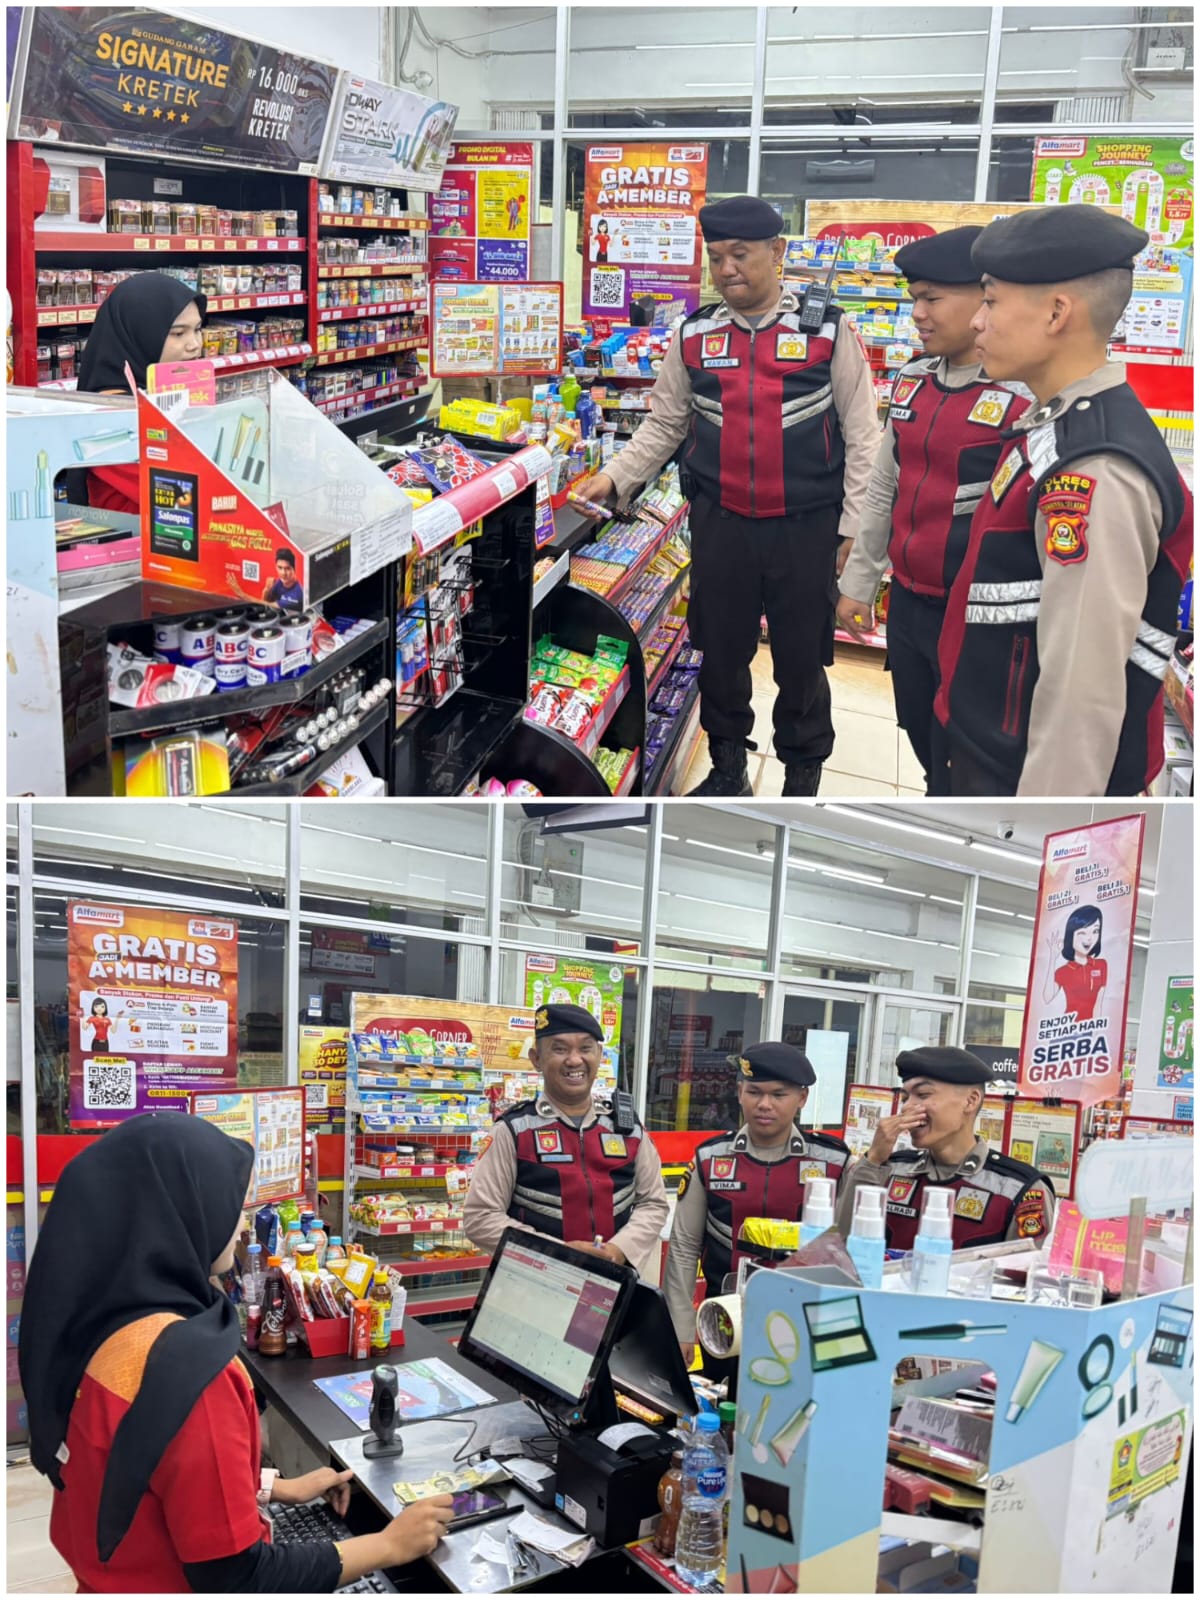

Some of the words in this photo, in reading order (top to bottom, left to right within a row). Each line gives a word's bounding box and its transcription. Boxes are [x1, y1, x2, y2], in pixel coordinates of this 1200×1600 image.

[143, 31, 175, 46] GUDANG
[176, 41, 207, 55] GARAM
[96, 32, 230, 88] SIGNATURE
[248, 68, 257, 80] RP
[258, 66, 298, 96] 16.000
[118, 73, 200, 108] KRETEK
[253, 98, 293, 122] REVOLUSI
[248, 118, 290, 141] KRETEK
[1041, 141, 1081, 150] Alfamart
[1096, 144, 1153, 153] SHOPPING
[1101, 152, 1149, 160] JOURNEY
[601, 167, 690, 186] GRATIS
[490, 267, 519, 276] 44.000
[155, 488, 175, 497] EXTRA
[155, 496, 175, 506] HOT
[212, 495, 238, 511] BARU!
[158, 510, 190, 524] Salonpas
[215, 640, 248, 654] ABC
[1053, 845, 1087, 857] Alfamart
[1075, 865, 1092, 875] BELI
[1075, 869, 1101, 882] GRATIS
[1097, 887, 1123, 899] GRATIS
[1098, 883, 1114, 892] BELI
[1047, 897, 1072, 908] GRATIS
[1048, 892, 1063, 901] BELI
[77, 907, 120, 920] Alfamart
[93, 933, 217, 966] GRATIS
[1040, 1013, 1076, 1029] ENJOY
[1038, 1025, 1077, 1040] SETIAP
[1079, 1018, 1107, 1032] HARI
[318, 1048, 347, 1057] HANY
[1033, 1036, 1108, 1064] SERBA
[993, 1058, 1018, 1071] coffe
[1029, 1055, 1109, 1082] GRATIS
[1091, 1229, 1114, 1240] LIP
[698, 1476, 716, 1485] Pure
